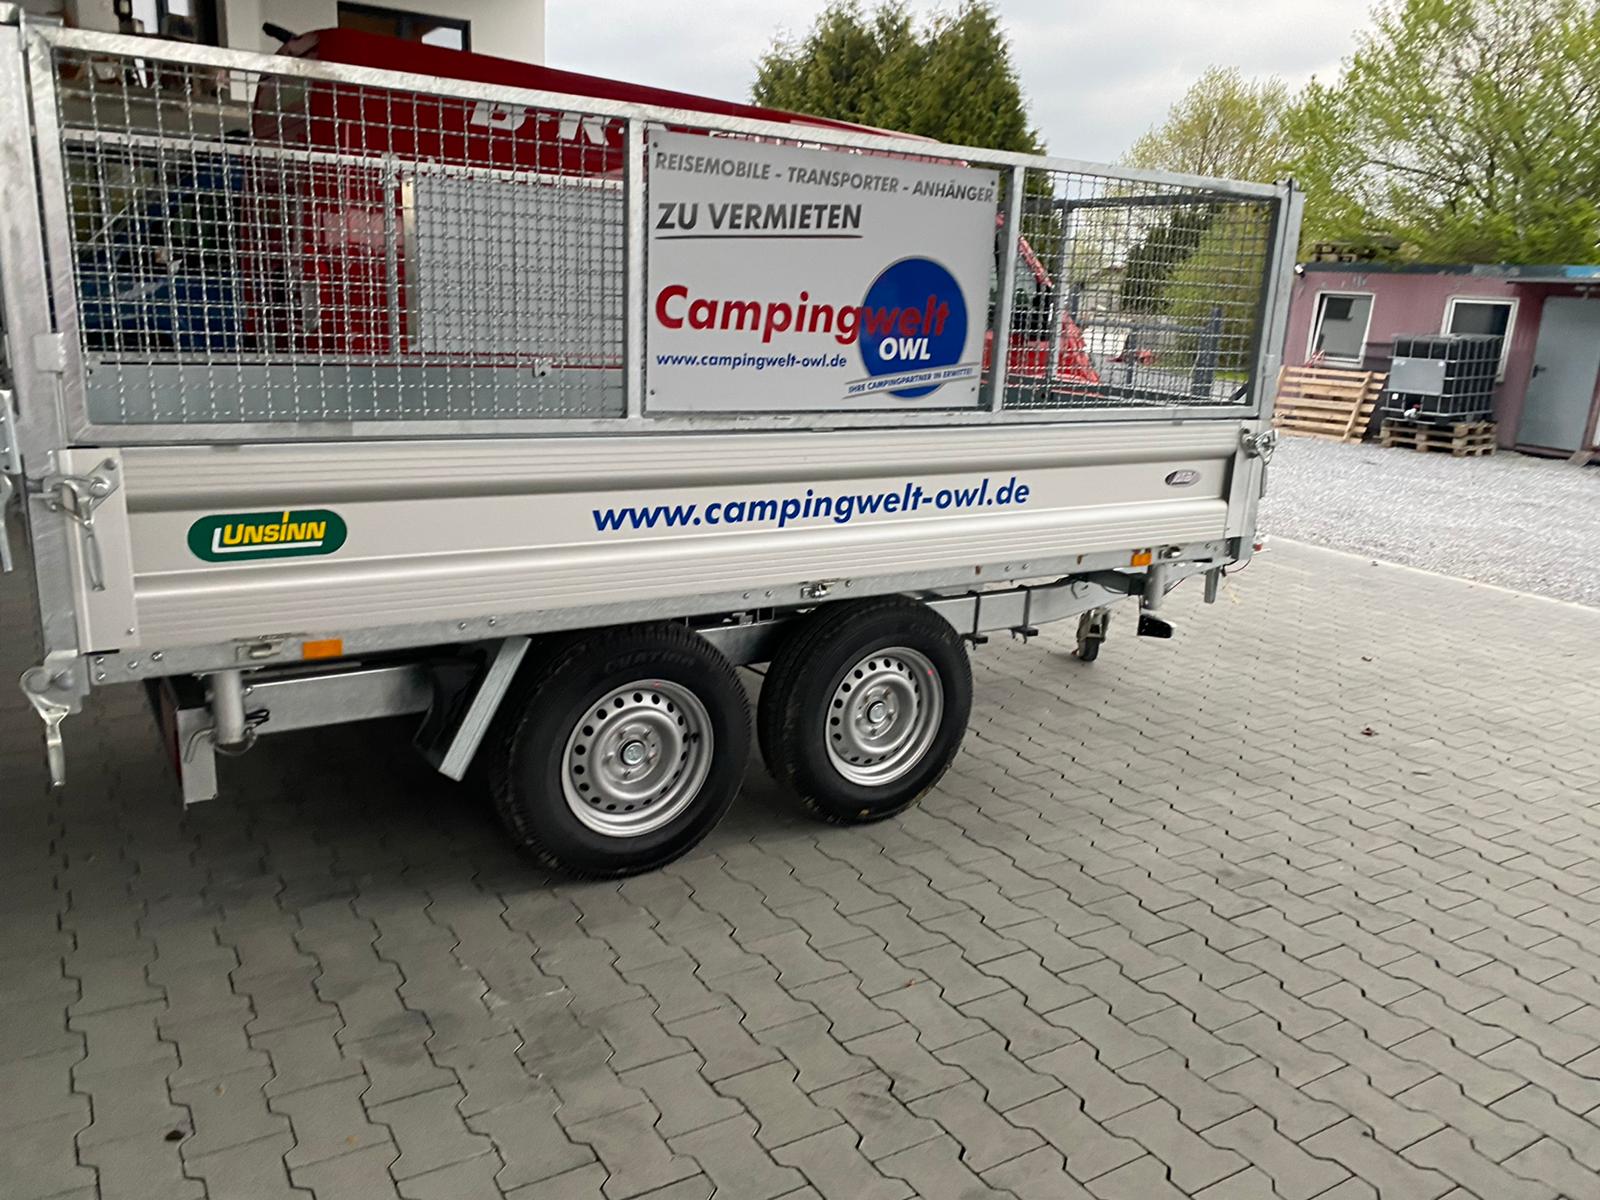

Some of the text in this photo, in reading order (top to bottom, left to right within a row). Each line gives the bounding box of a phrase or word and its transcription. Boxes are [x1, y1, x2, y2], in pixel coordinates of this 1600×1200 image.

[654, 152, 771, 180] REISEMOBILE
[788, 166, 899, 193] TRANSPORTER
[912, 179, 994, 202] ANHÄNGER
[656, 203, 862, 230] ZU VERMIETEN
[655, 284, 949, 345] Campingwelt
[656, 353, 847, 370] www.campingwelt-owl.de
[879, 337, 931, 361] OWL
[593, 477, 1030, 530] www.campingwelt-owl.de
